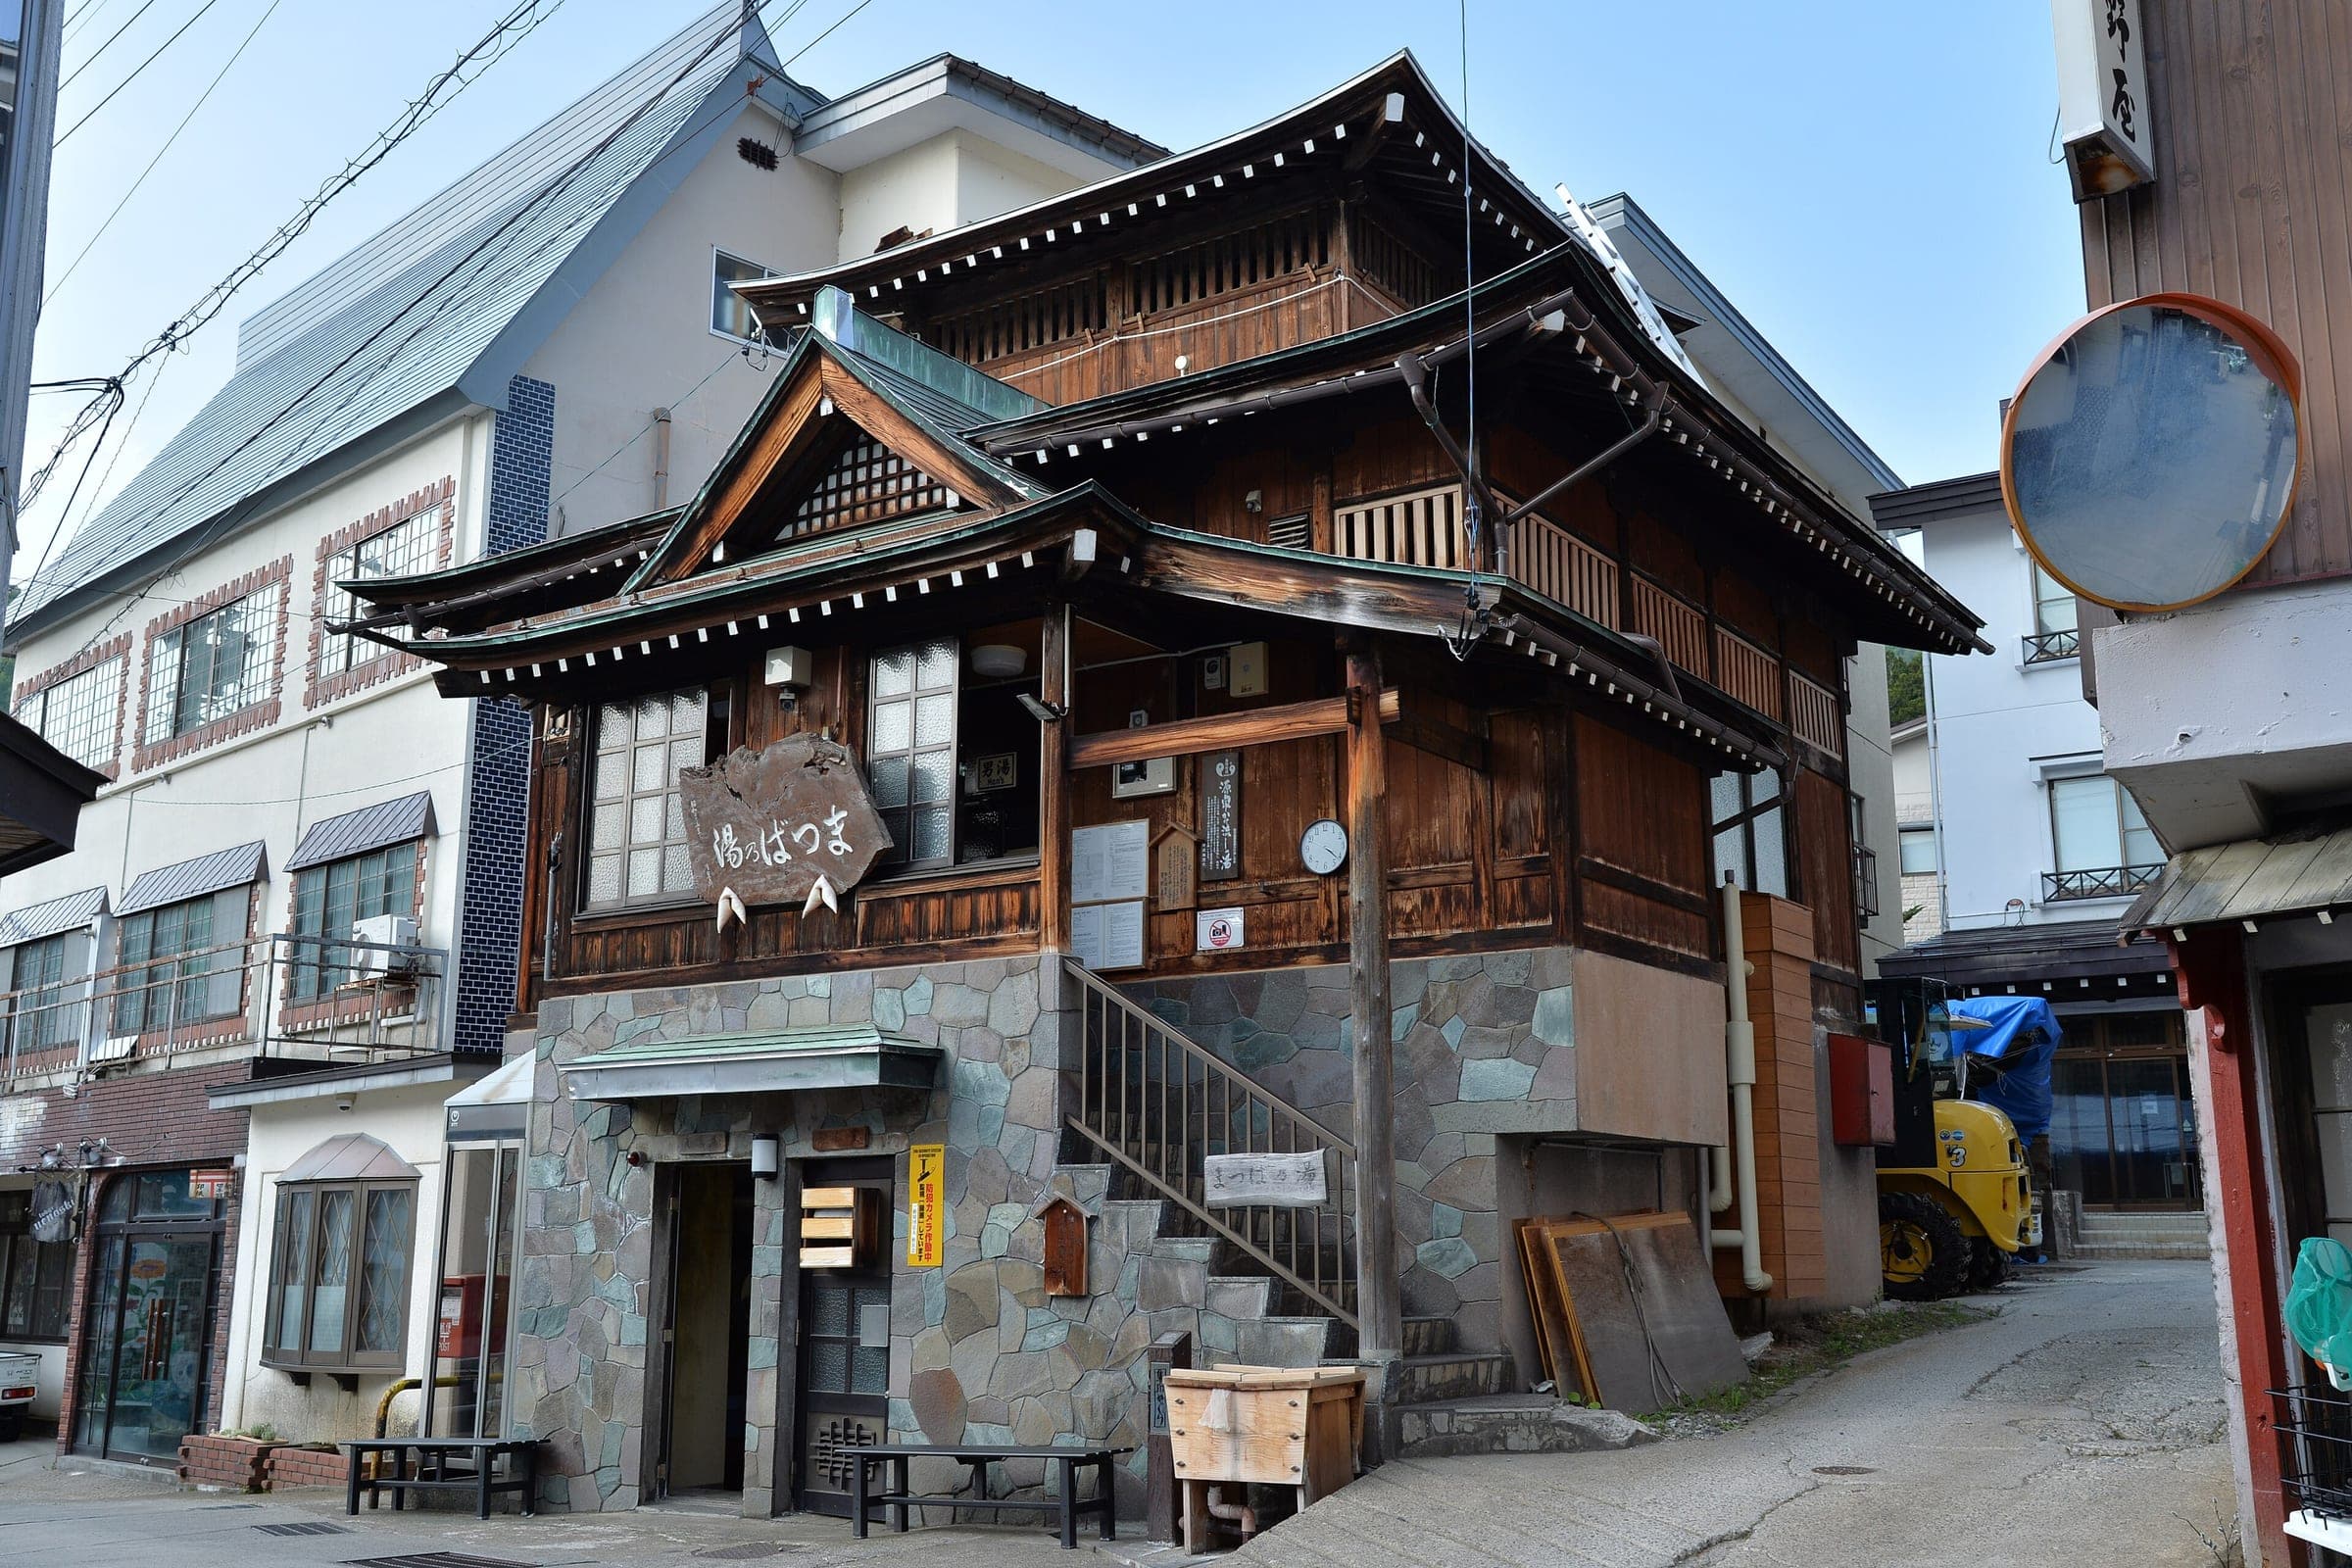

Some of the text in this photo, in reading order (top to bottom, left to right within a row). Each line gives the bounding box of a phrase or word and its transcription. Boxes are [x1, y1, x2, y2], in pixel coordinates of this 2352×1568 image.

[924, 1183, 934, 1262] 防犯カメラ作動中
